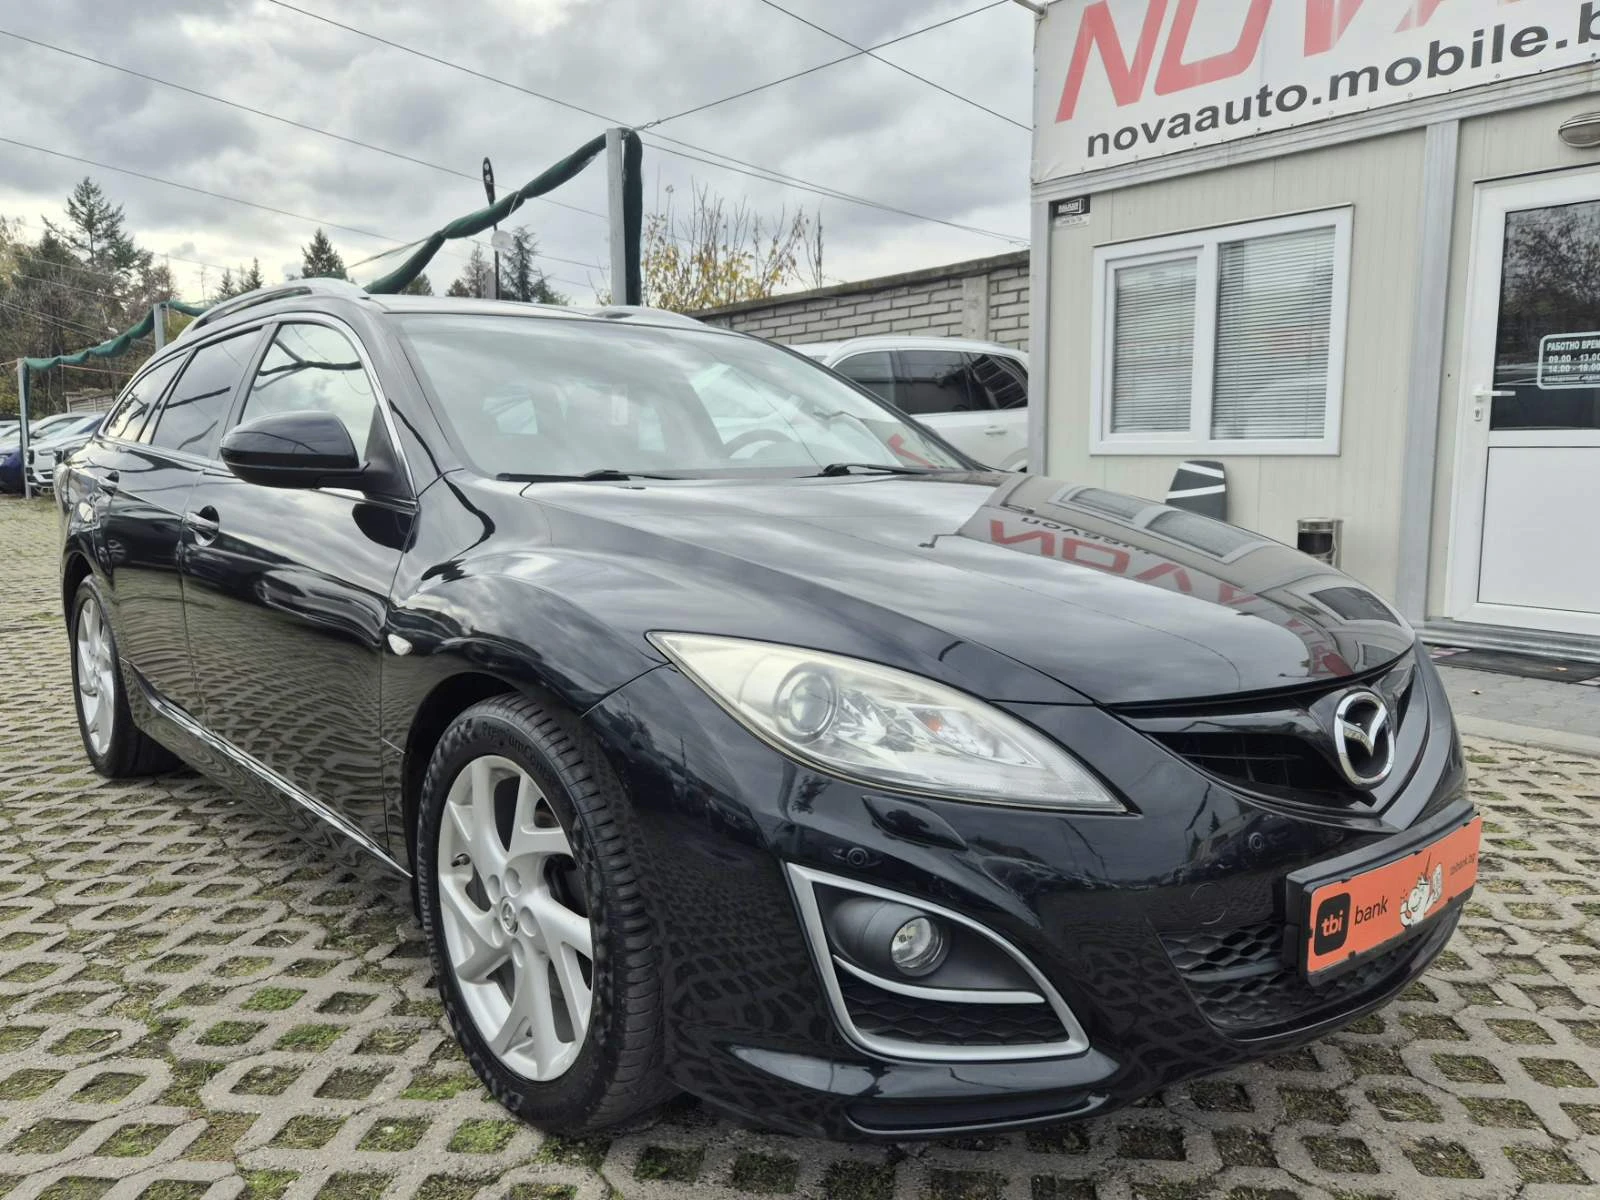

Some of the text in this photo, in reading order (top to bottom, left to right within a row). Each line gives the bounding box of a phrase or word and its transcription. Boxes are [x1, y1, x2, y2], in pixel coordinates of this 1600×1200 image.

[1055, 0, 1520, 122] NOV
[1086, 1, 1600, 157] novaauto.mobile.b
[1547, 341, 1580, 351] РАБОТНО
[1548, 355, 1571, 364] 09.00
[1320, 896, 1389, 937] tbi bank
